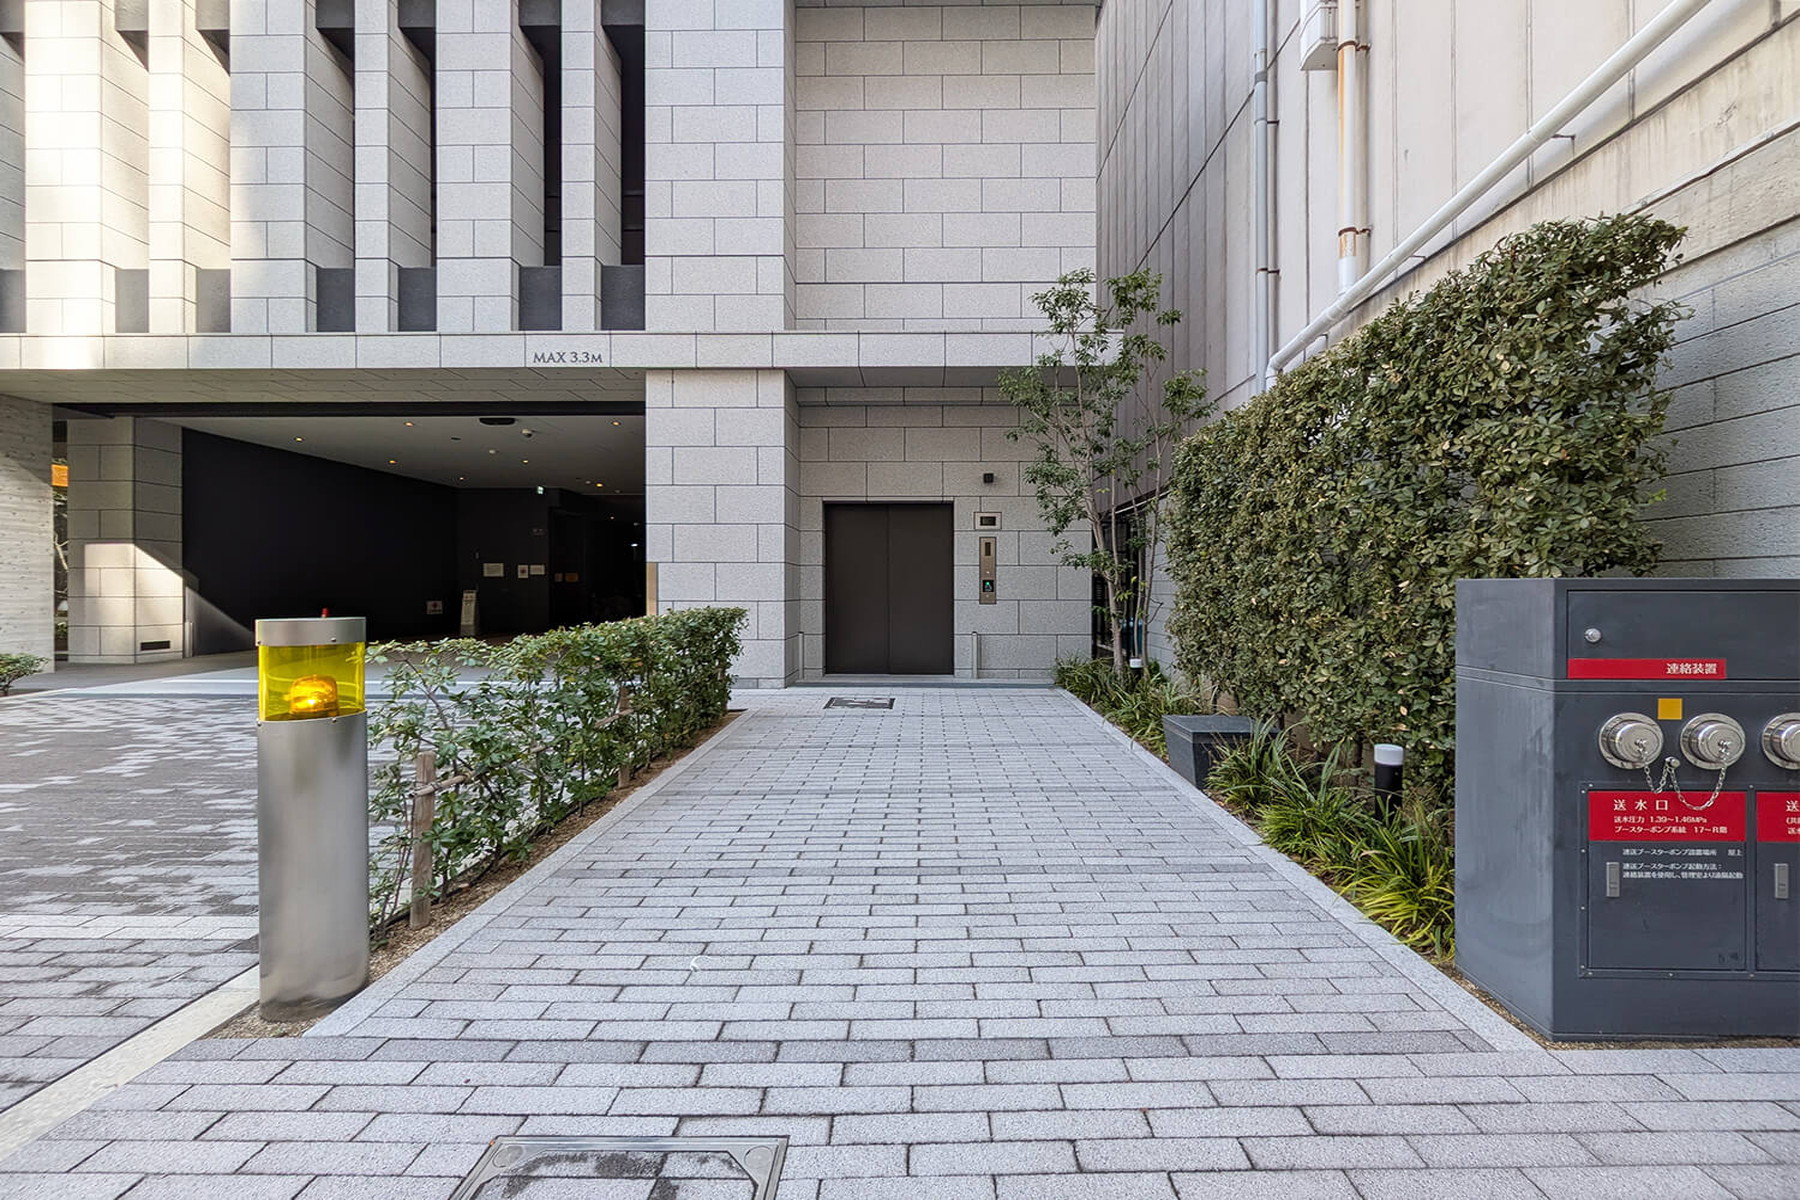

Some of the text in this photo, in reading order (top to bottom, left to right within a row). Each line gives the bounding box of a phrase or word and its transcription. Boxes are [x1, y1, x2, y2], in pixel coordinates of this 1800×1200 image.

[533, 351, 603, 364] MAX 3.3M
[1666, 662, 1718, 675] 連絡装置
